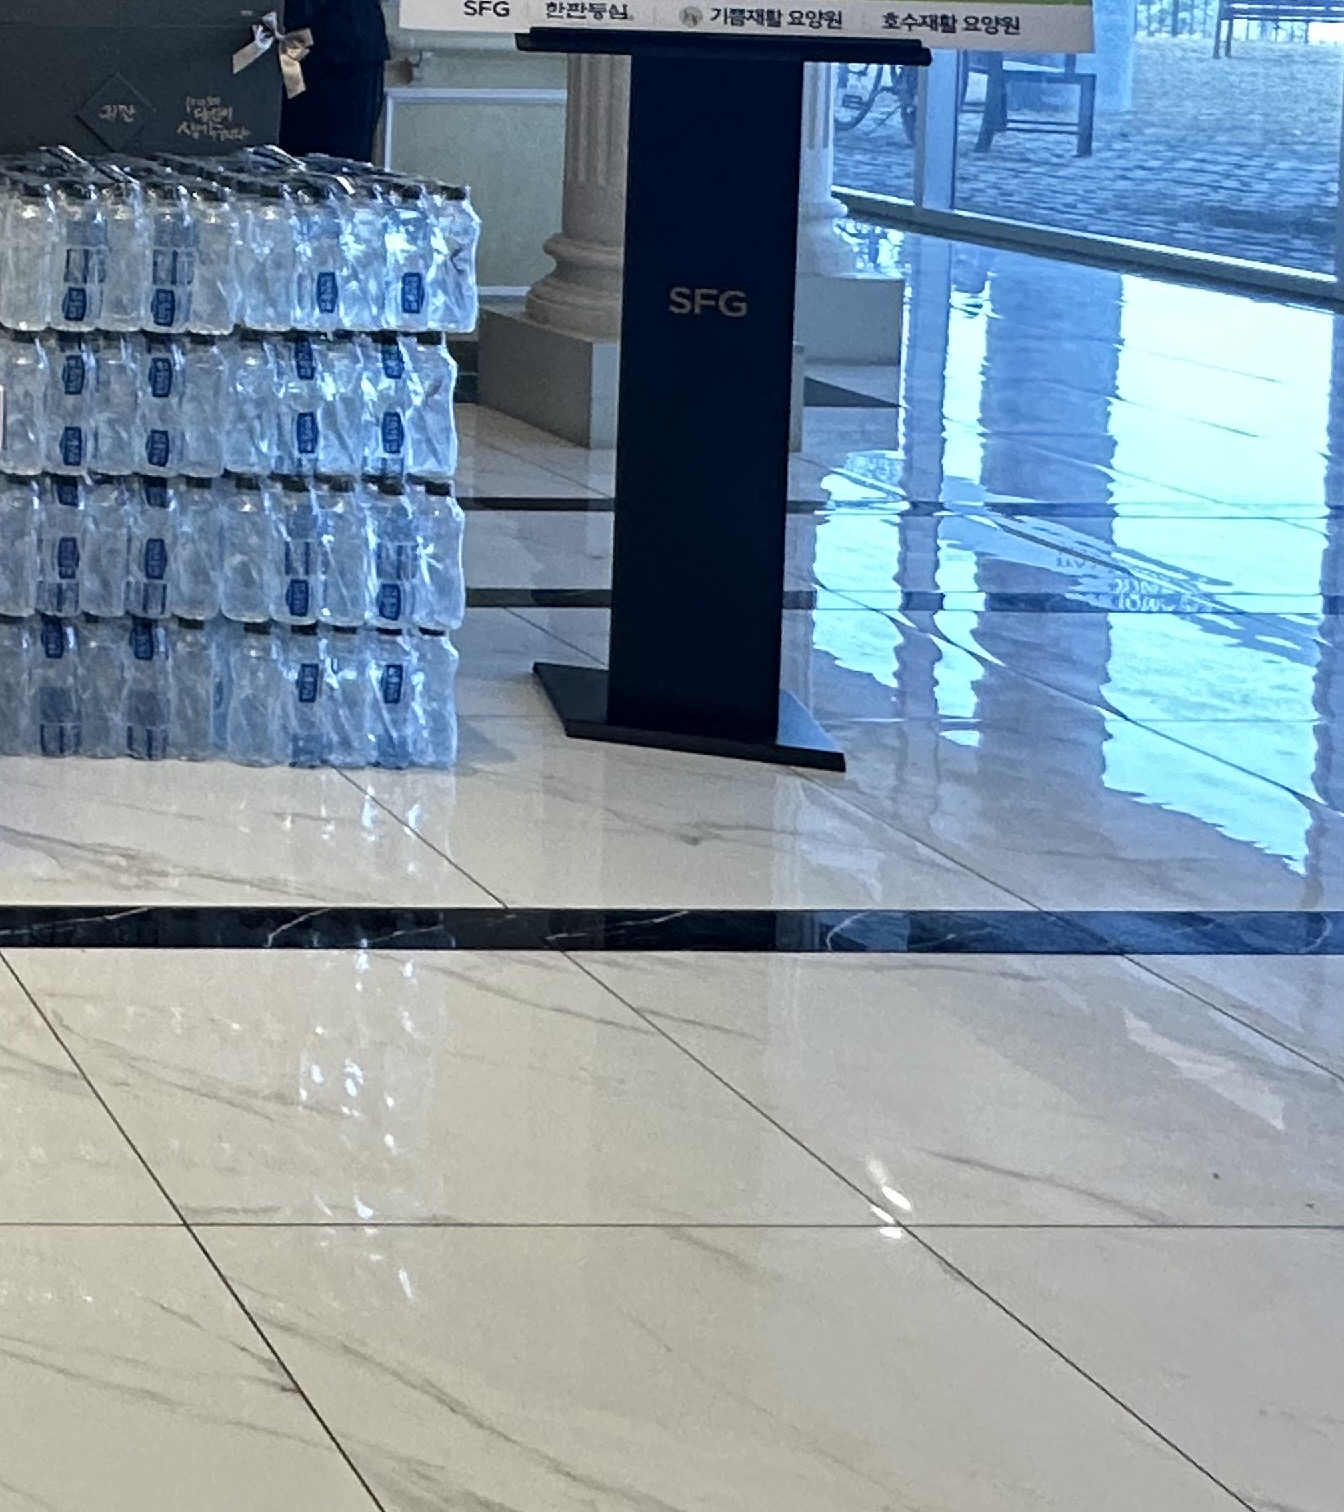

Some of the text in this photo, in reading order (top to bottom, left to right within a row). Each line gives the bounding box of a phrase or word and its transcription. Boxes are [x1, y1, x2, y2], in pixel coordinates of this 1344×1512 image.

[463, 0, 510, 18] SFG
[710, 7, 783, 29] 기쁨재활
[787, 9, 843, 31] 요양원
[882, 11, 958, 35] 호수재활
[962, 14, 1021, 37] 요양원
[668, 287, 748, 318] SFG
